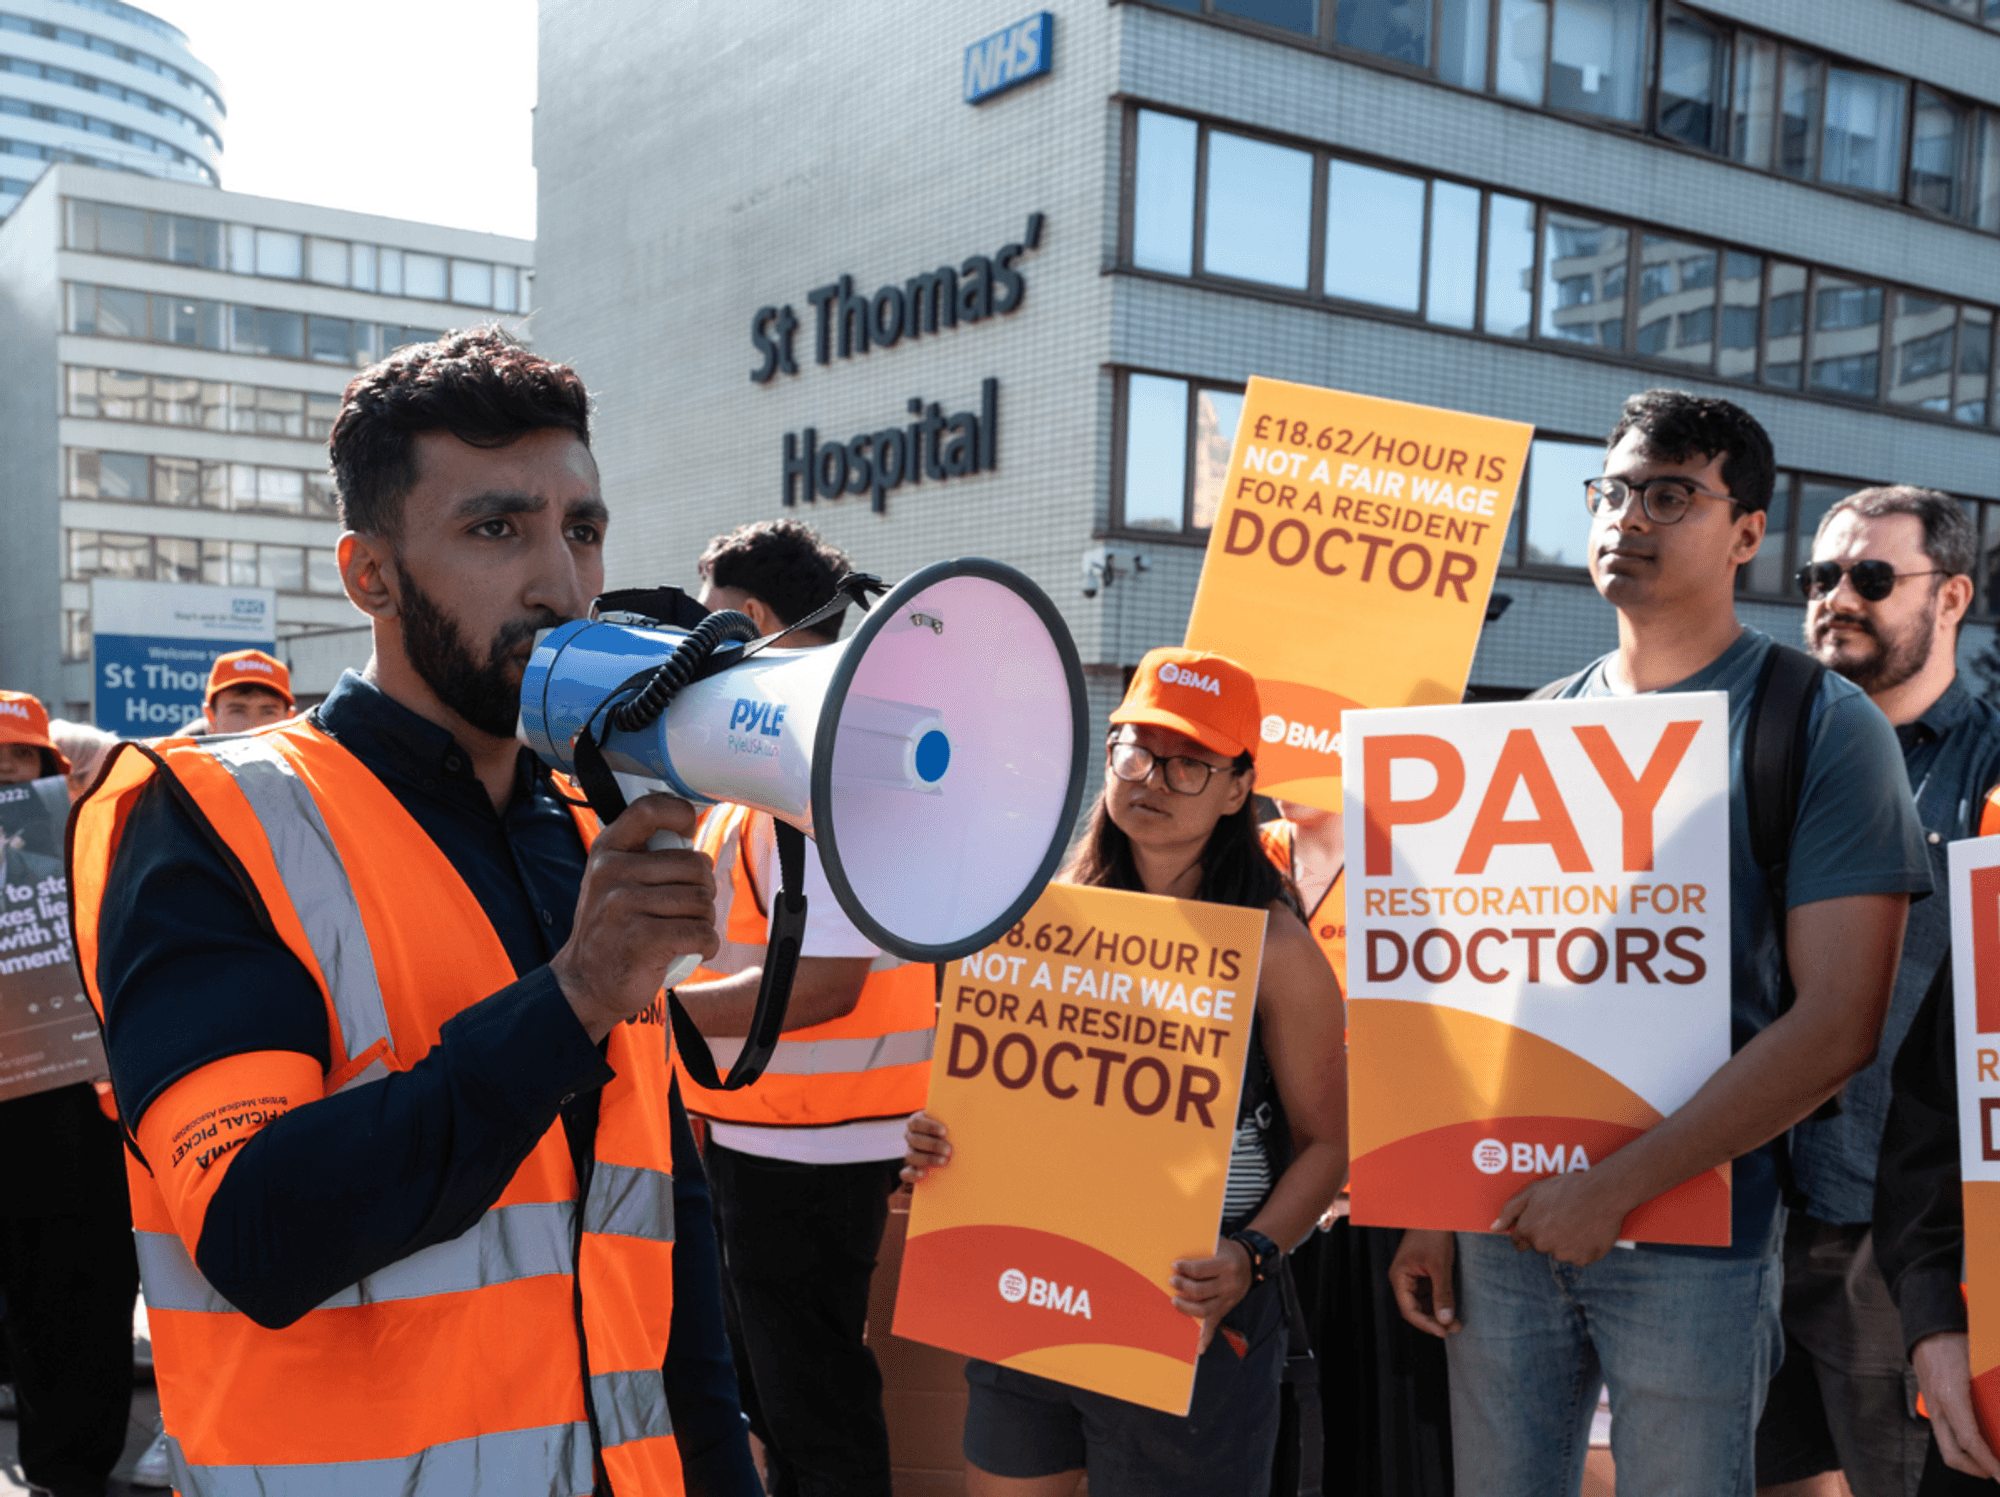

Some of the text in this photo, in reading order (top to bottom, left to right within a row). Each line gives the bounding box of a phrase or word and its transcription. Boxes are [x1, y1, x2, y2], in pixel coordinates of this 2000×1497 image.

[966, 17, 1041, 98] NHS
[750, 211, 1045, 383] St Thomas'
[782, 377, 1000, 514] Hospital
[1254, 414, 1506, 483] £18.62/HOUR IS
[1236, 477, 1491, 546] FOR A RESIDENT
[1243, 445, 1500, 516] NOT A FAIR WAGE
[1224, 508, 1478, 603] DOCTOR
[104, 662, 136, 689] St
[1178, 669, 1220, 696] BMA
[730, 698, 787, 737] PYLE
[1286, 721, 1343, 758] BMA
[1363, 719, 1704, 877] PAY
[5, 884, 34, 902] to
[1364, 883, 1707, 917] RESTORATION FOR
[995, 919, 1242, 981] 8.62/HOUR IS
[1365, 926, 1708, 985] DOCTORS
[960, 950, 1237, 1021] NOT A FAIR WAGE
[955, 985, 1231, 1059] FOR A RESIDENT
[946, 1022, 1222, 1129] DOCTOR
[172, 1123, 218, 1168] PICKET
[1511, 1142, 1591, 1175] BMA
[1027, 1278, 1092, 1320] BMA
